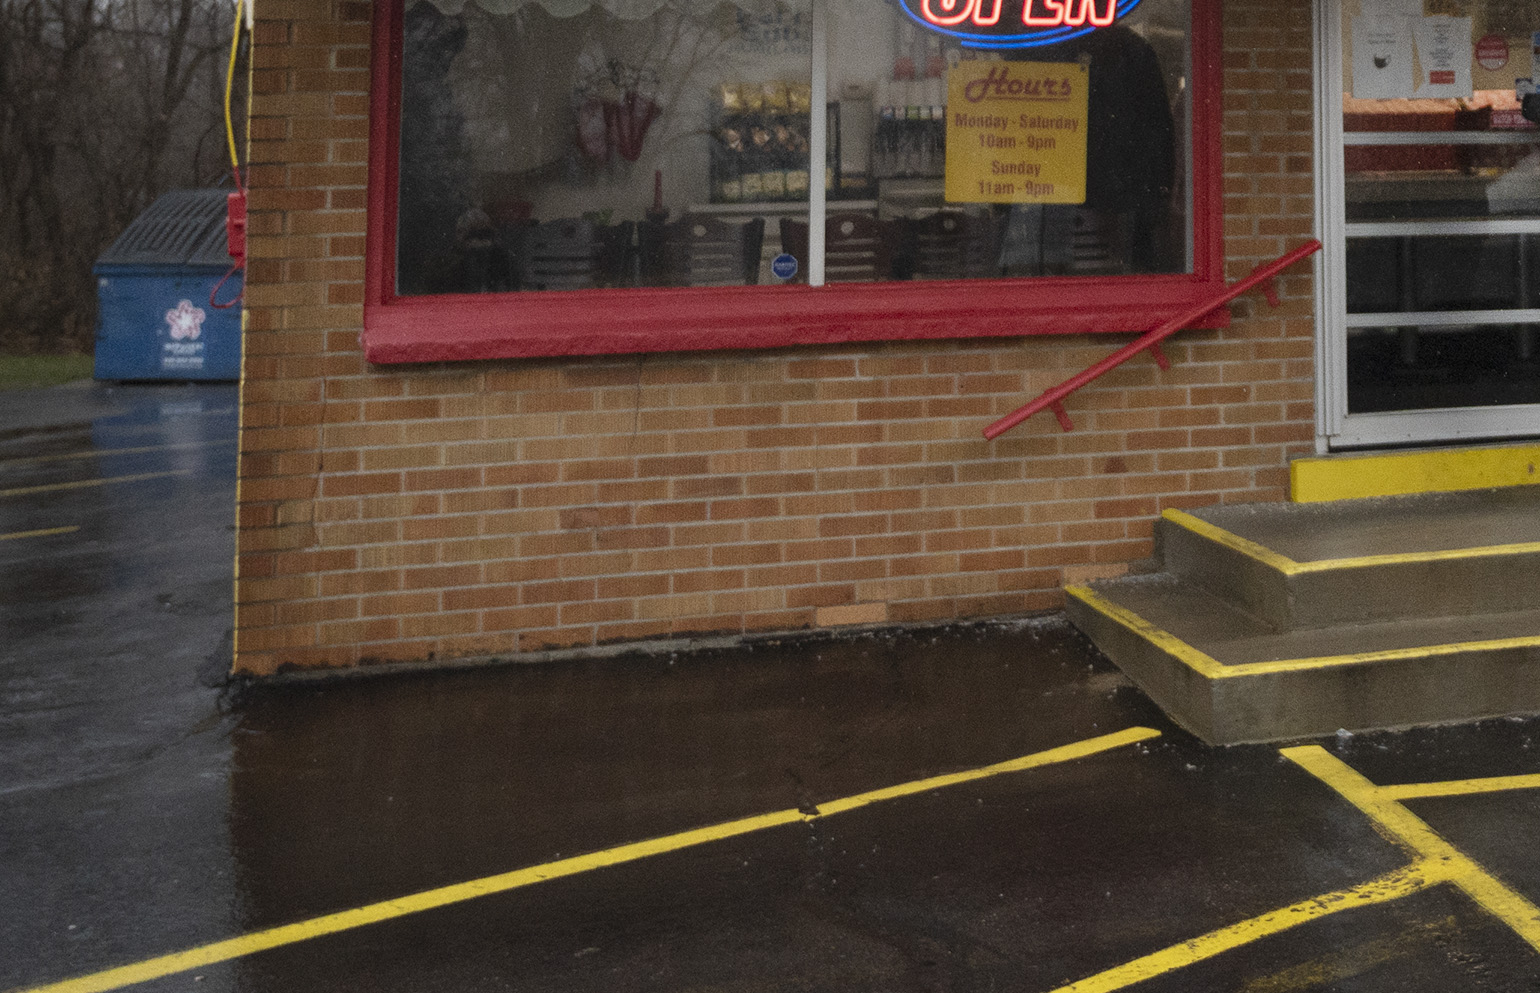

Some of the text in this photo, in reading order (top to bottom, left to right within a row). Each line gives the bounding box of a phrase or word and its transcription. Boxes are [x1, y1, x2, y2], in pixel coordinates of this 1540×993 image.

[964, 66, 1072, 103] Hours
[955, 113, 1008, 131] Monday
[1019, 114, 1079, 133] Saturday
[979, 134, 1016, 149] 10am
[1026, 135, 1056, 151] 9pm
[991, 160, 1041, 177] Sunday
[978, 180, 1014, 195] 11am
